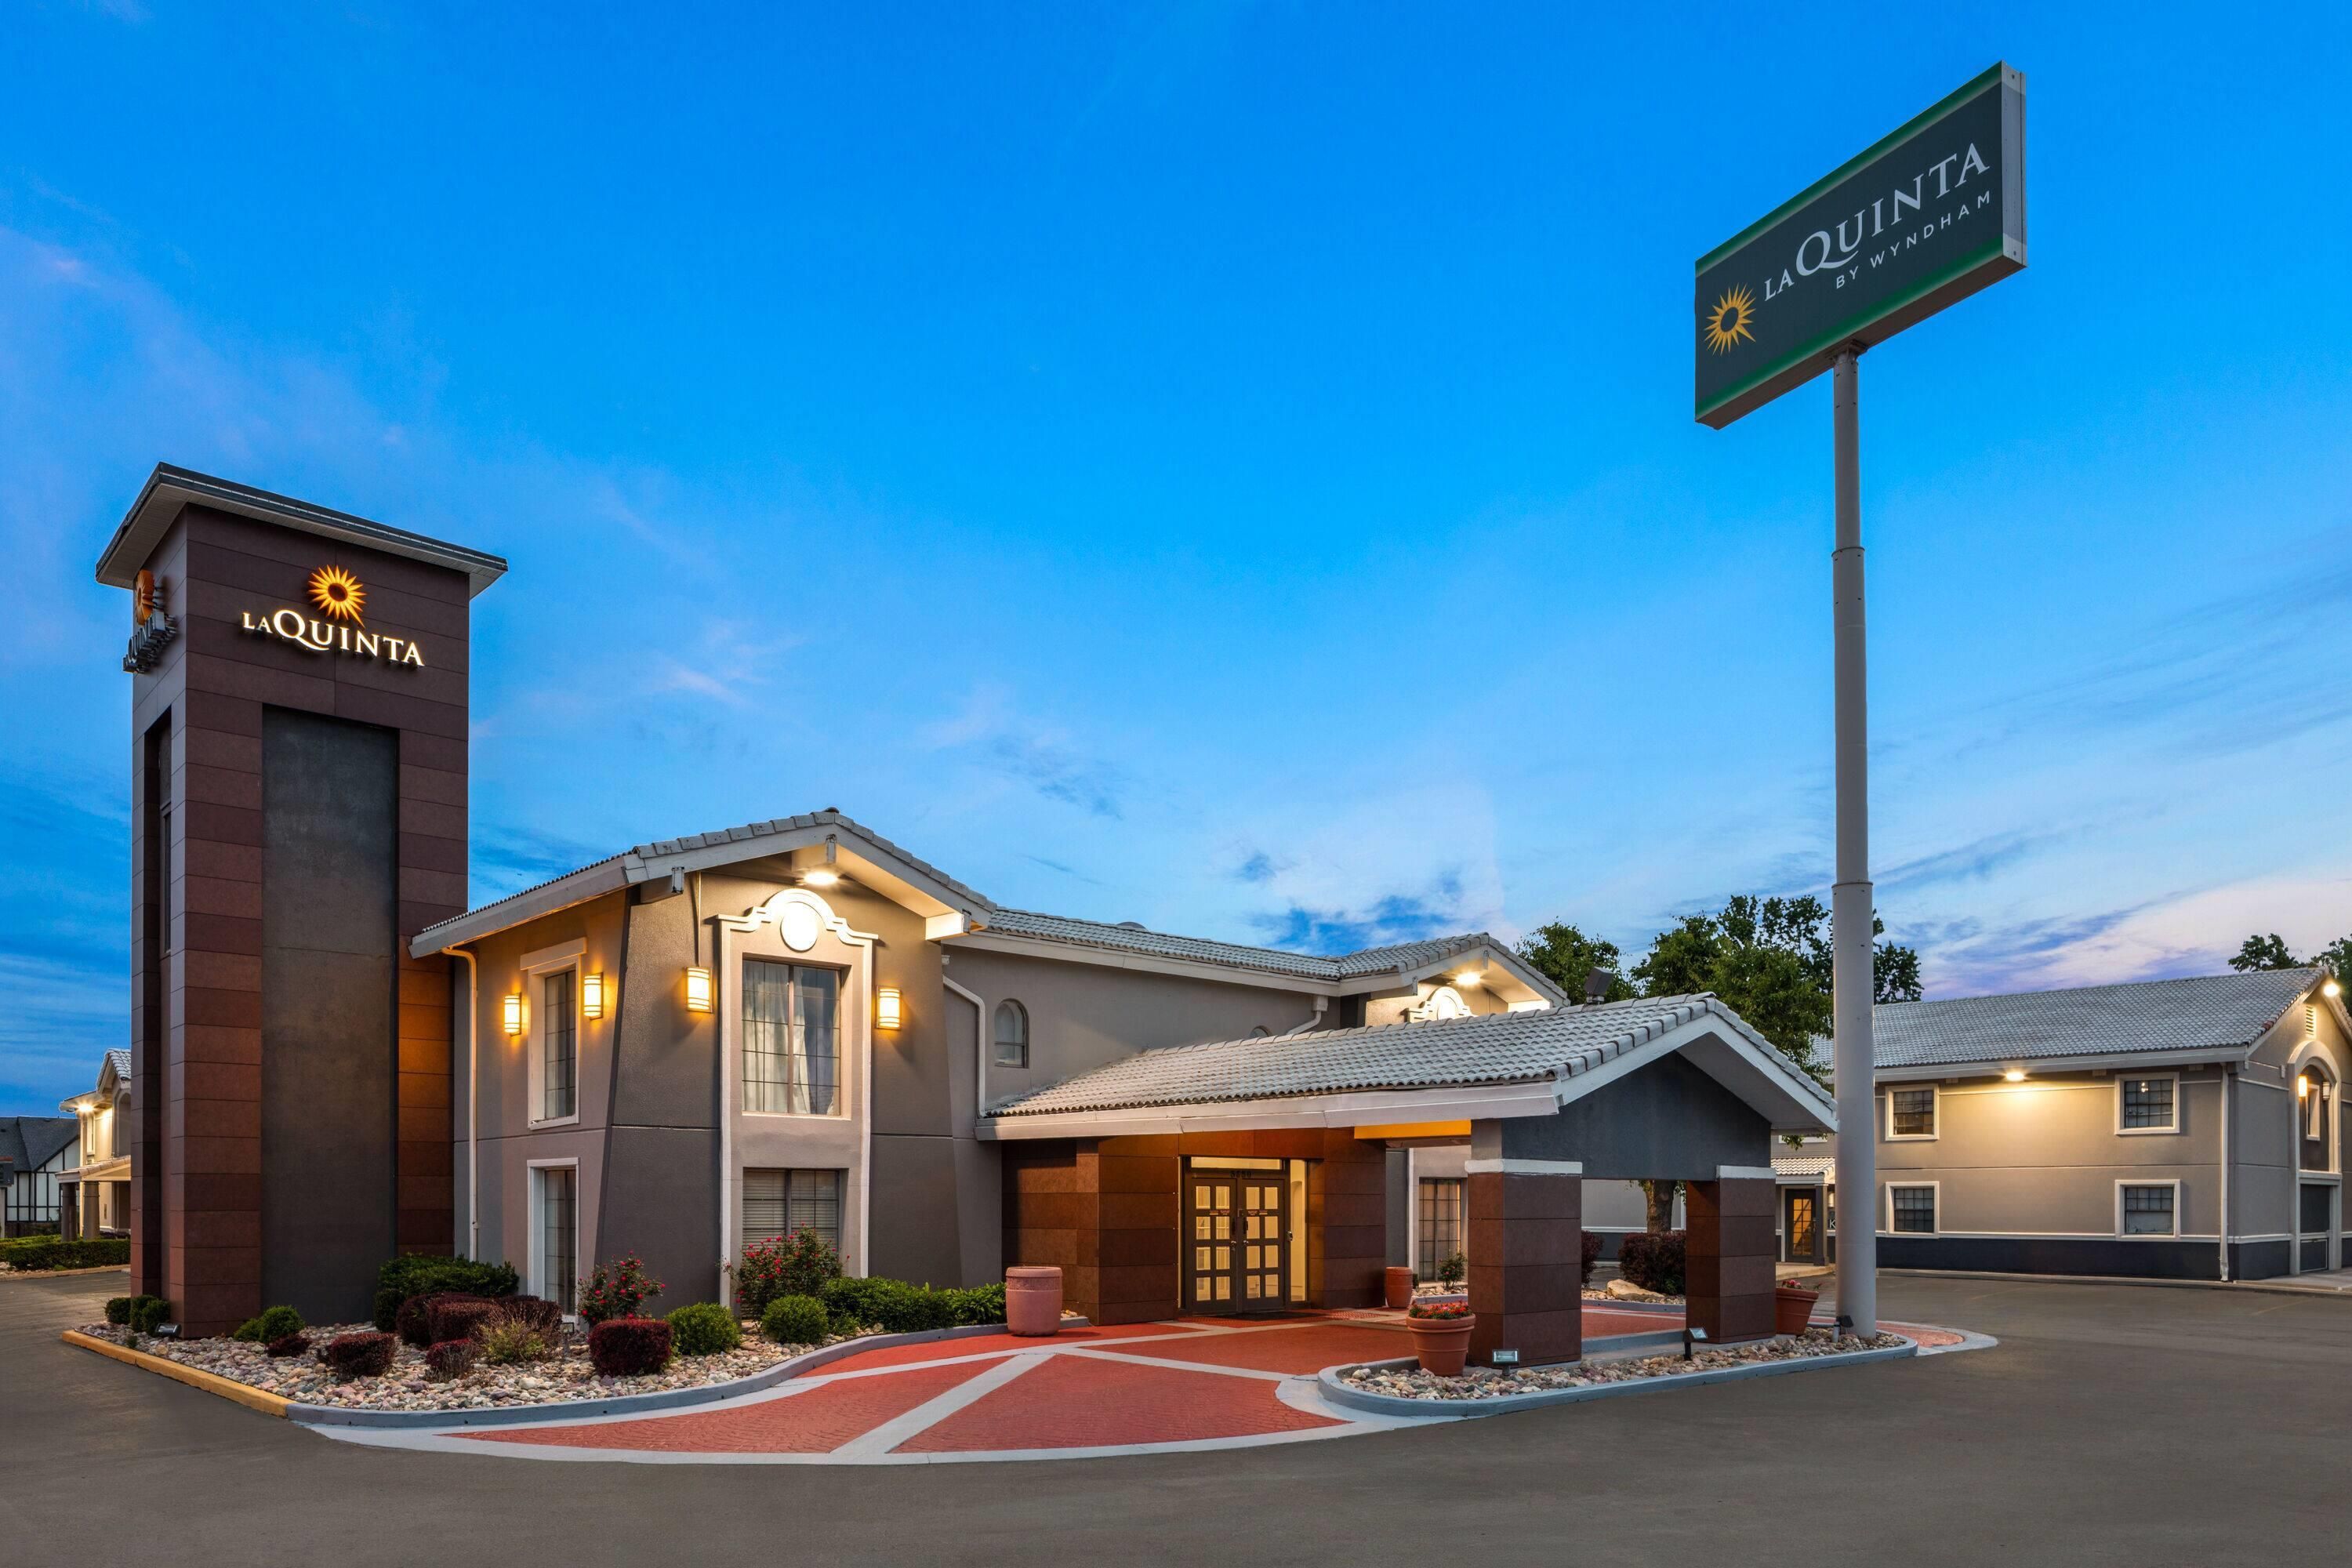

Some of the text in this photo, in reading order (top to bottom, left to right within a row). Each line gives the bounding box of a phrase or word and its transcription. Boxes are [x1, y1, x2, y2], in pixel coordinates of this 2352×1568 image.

[1764, 143, 1990, 302] LA QUINTA
[1836, 191, 1990, 289] BY WYNDHAM
[242, 609, 425, 666] LA QUINTA
